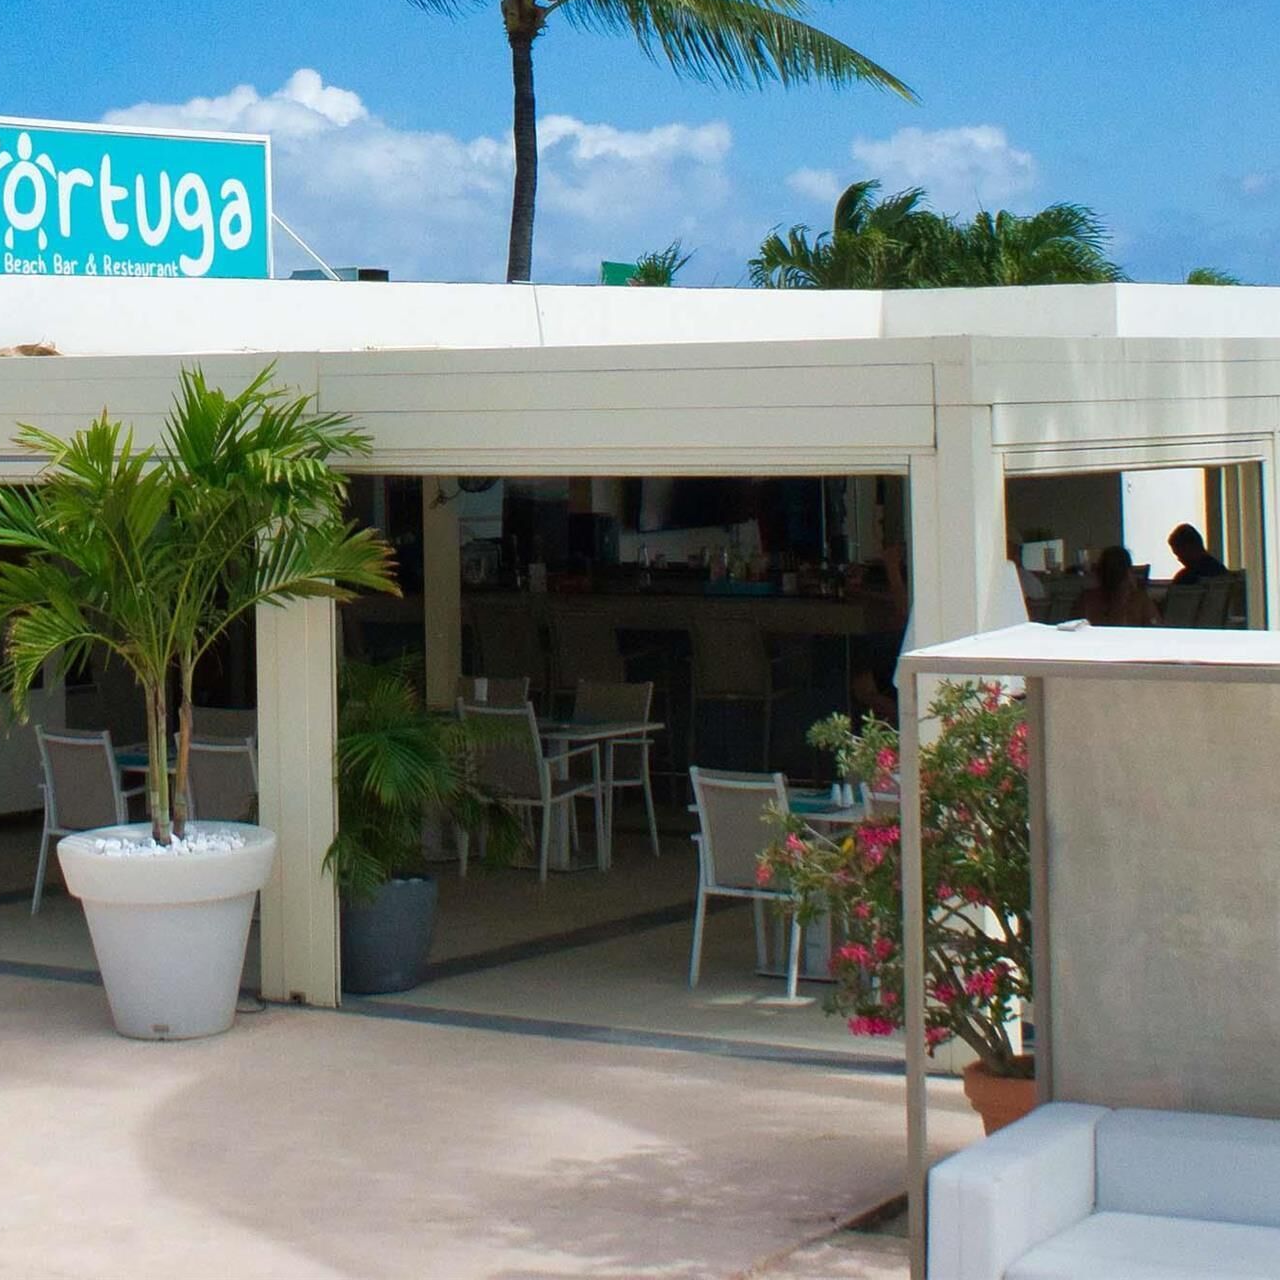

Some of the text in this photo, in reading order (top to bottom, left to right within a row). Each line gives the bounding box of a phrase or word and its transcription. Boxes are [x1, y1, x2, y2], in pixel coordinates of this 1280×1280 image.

[4, 252, 179, 277] Beach Bar & Restaurant
